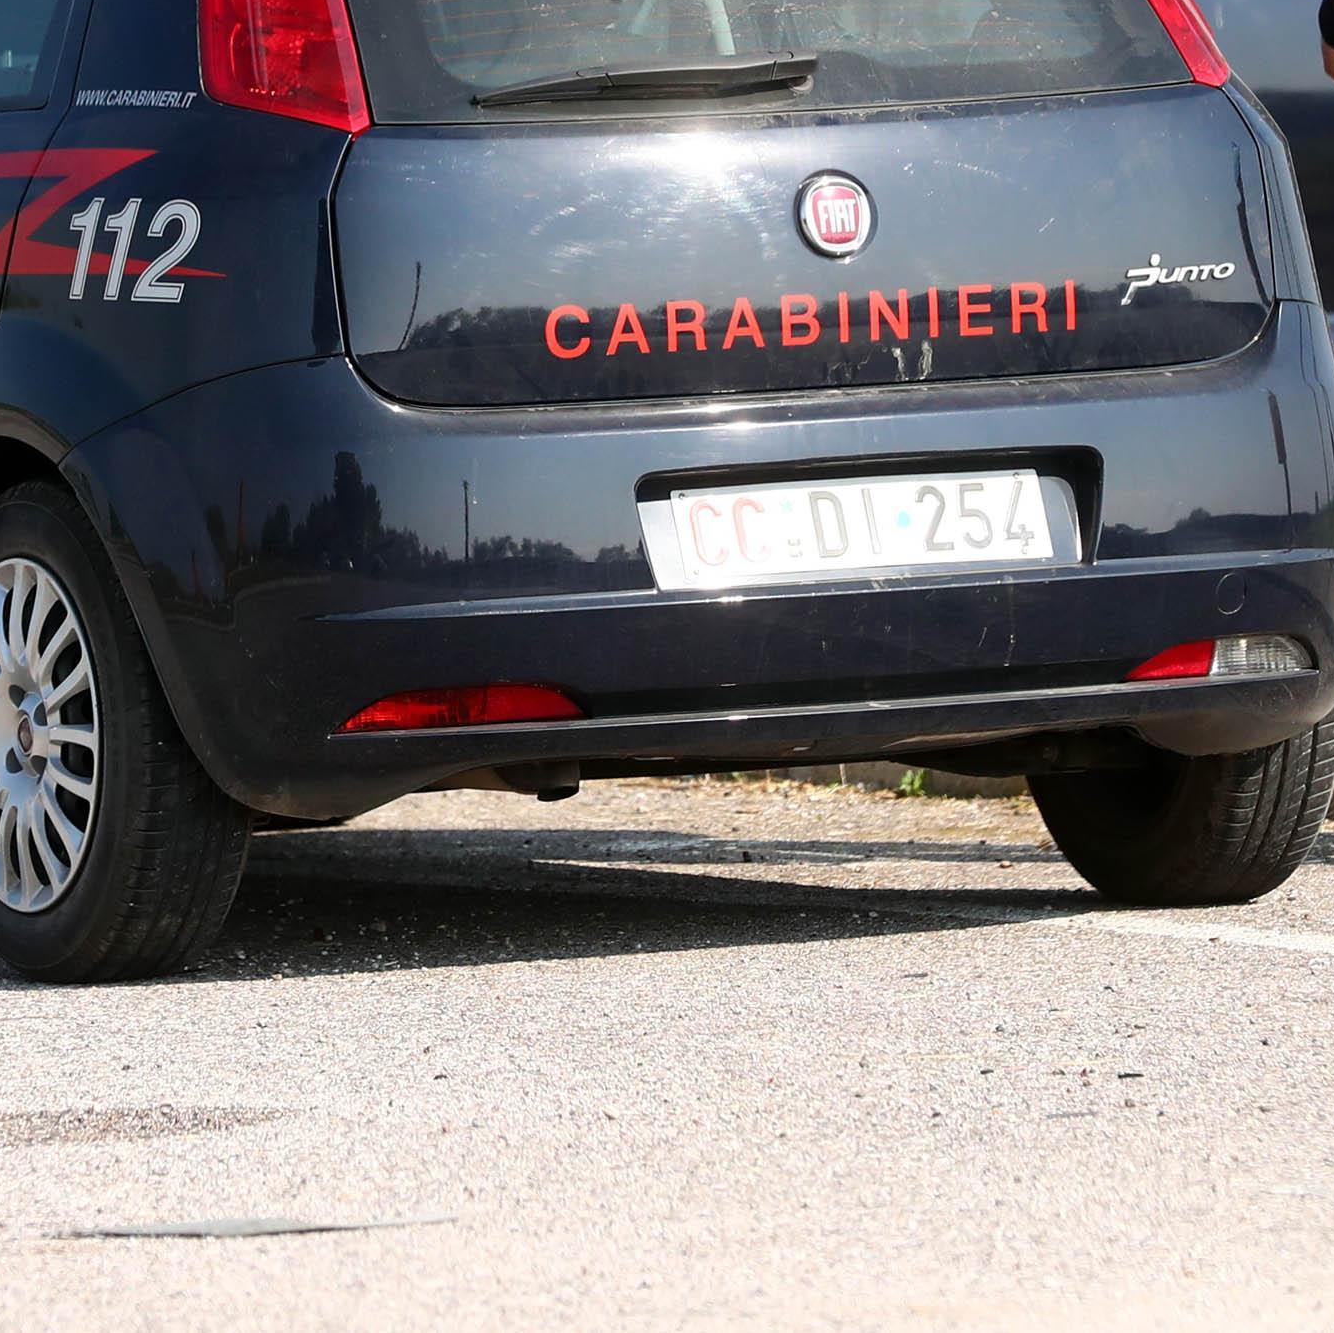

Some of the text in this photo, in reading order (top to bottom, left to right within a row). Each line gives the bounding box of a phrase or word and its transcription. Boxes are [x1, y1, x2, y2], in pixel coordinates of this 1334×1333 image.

[75, 89, 196, 109] WWW.CARABINIERI.IT
[68, 197, 201, 304] 112
[817, 198, 857, 235] FIAT
[544, 279, 1077, 359] CARABINIERI
[688, 480, 1035, 566] CC DI 254
